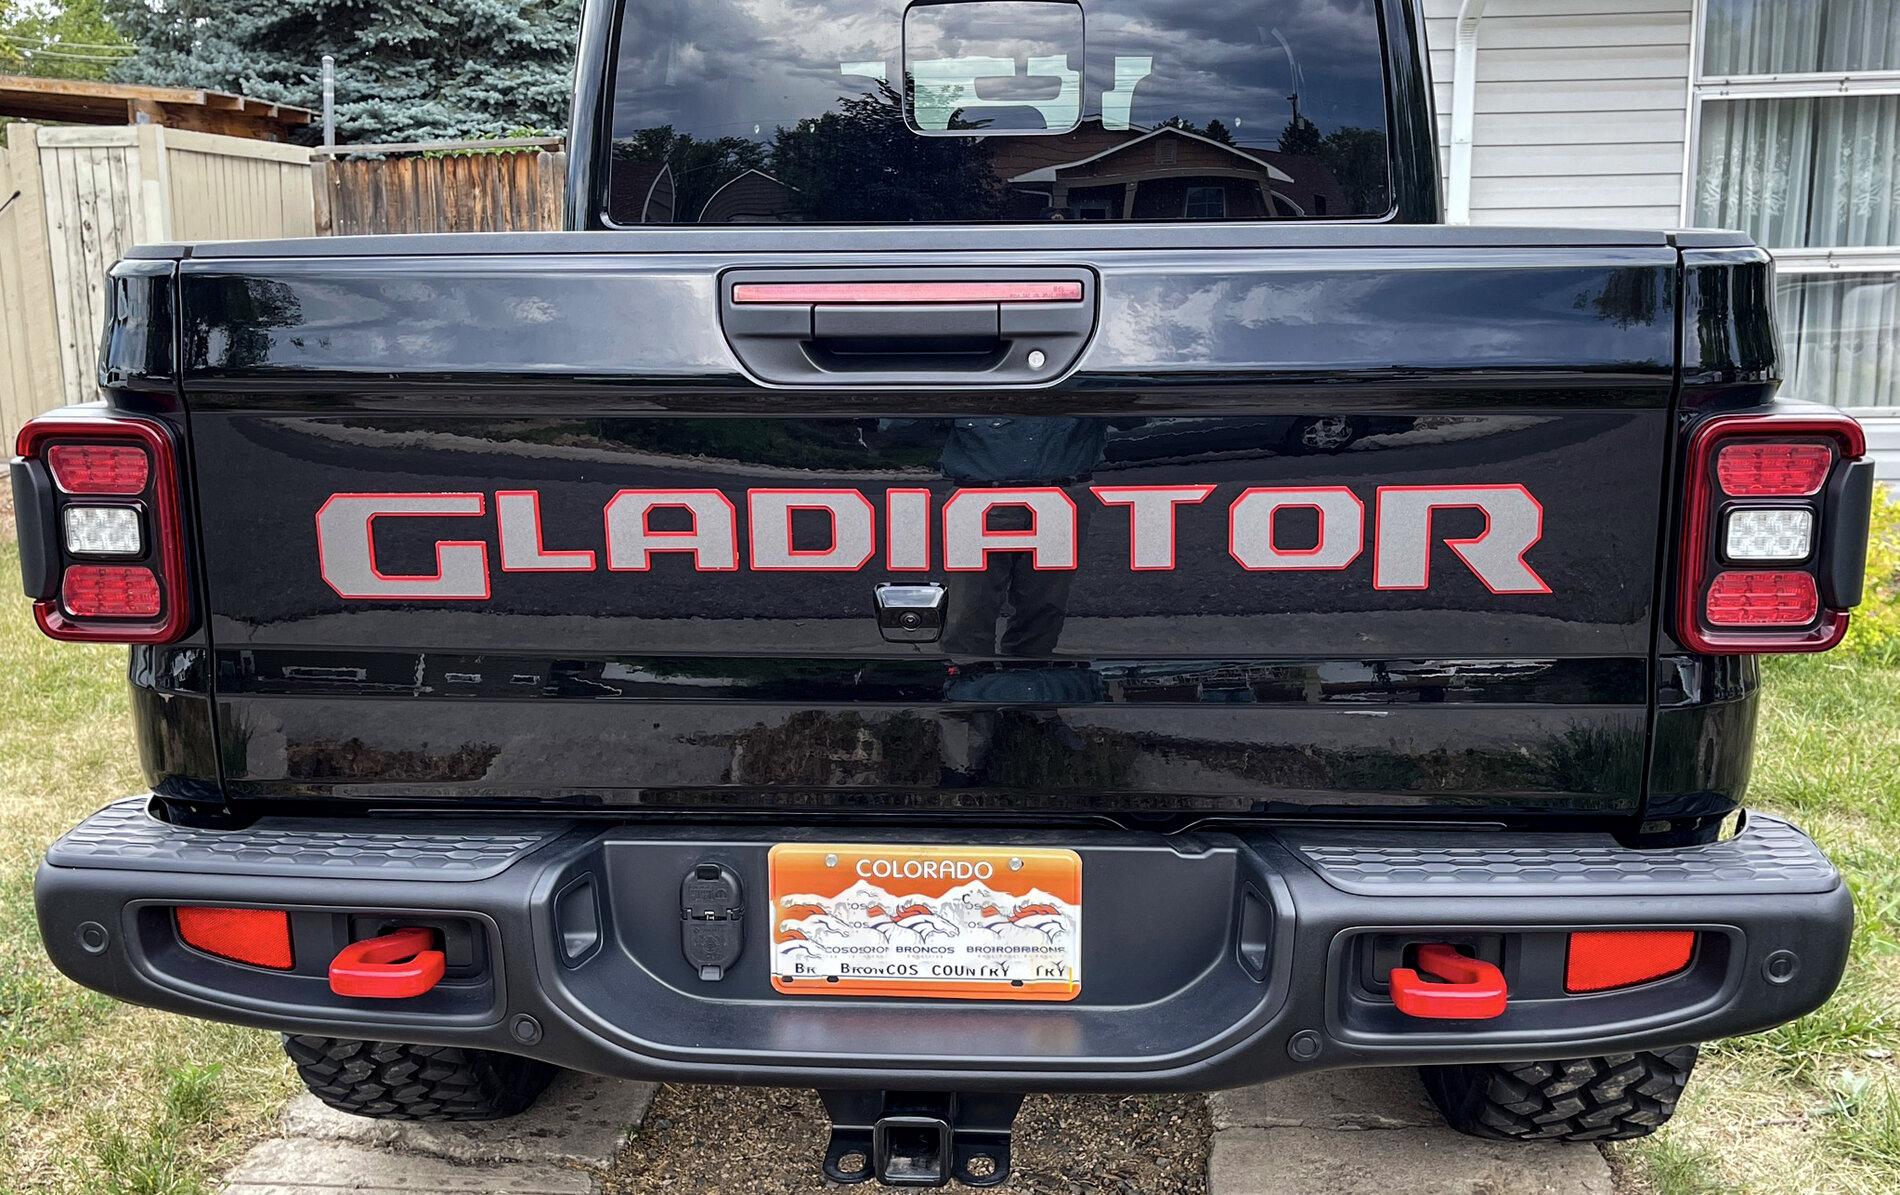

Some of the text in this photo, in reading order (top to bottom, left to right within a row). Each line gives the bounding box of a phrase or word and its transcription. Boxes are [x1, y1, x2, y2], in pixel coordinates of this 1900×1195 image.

[316, 484, 1553, 599] GLADIATOR
[856, 860, 993, 879] COLORADO
[895, 946, 955, 954] BRONCOS
